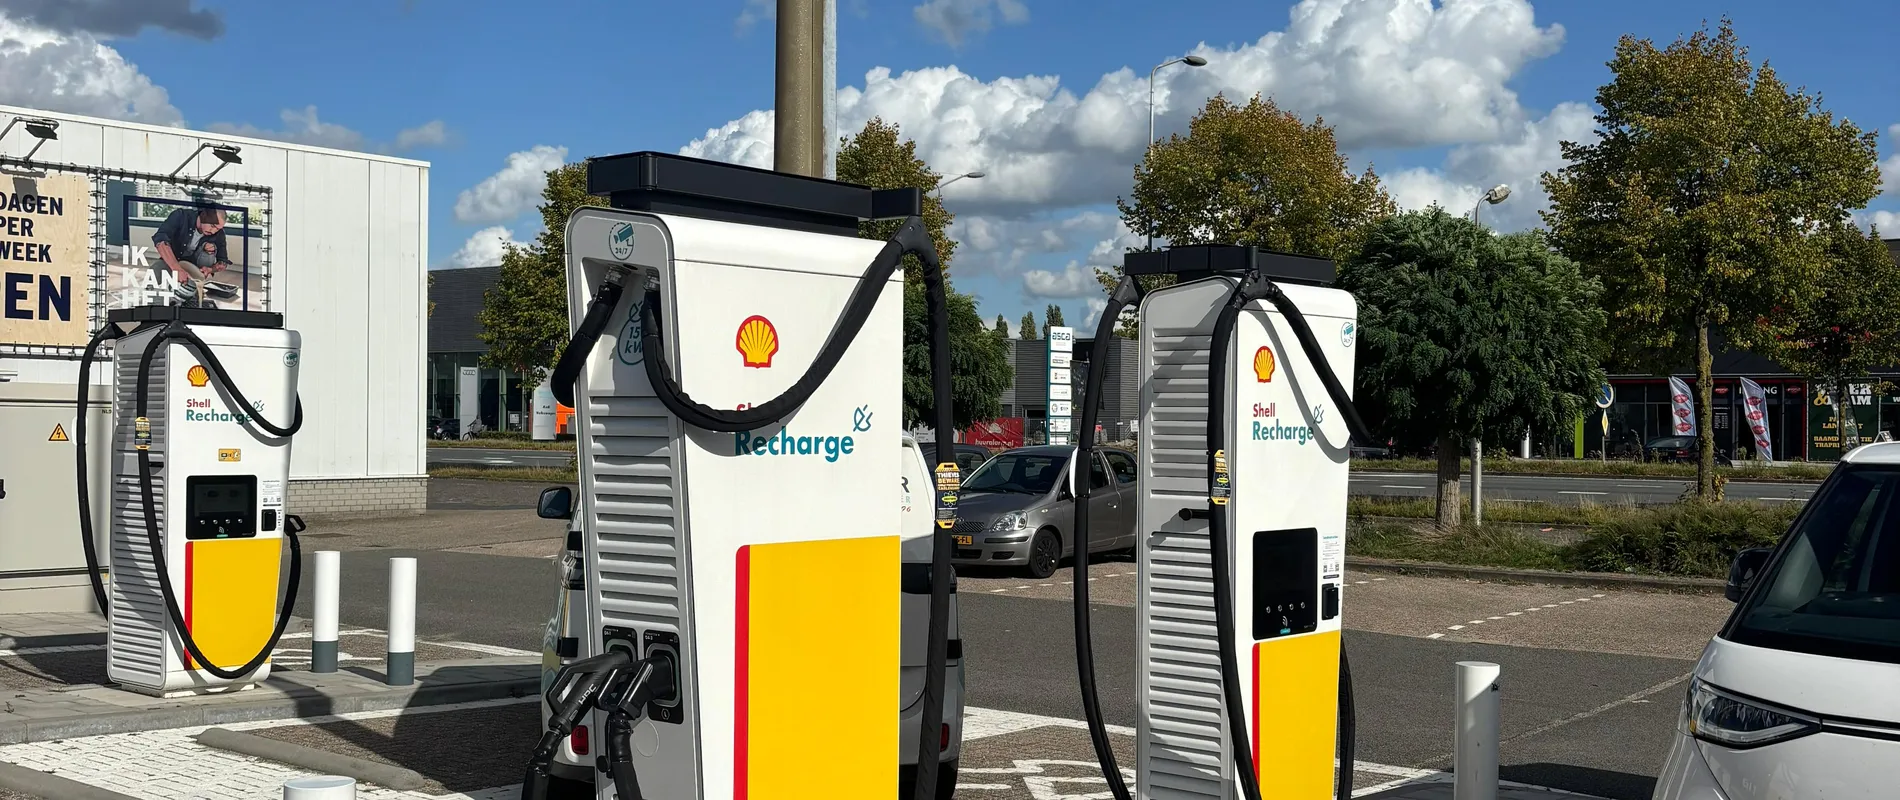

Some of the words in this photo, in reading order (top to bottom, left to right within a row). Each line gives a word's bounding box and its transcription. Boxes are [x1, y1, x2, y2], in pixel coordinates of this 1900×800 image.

[122, 244, 149, 267] IK
[122, 267, 179, 290] KAN
[4, 272, 72, 322] EN
[629, 326, 642, 339] 15
[186, 399, 211, 408] Shell
[1253, 403, 1276, 418] Shell
[186, 409, 254, 426] Recharge
[1252, 419, 1315, 446] Recharge
[735, 426, 855, 464] Recharge
